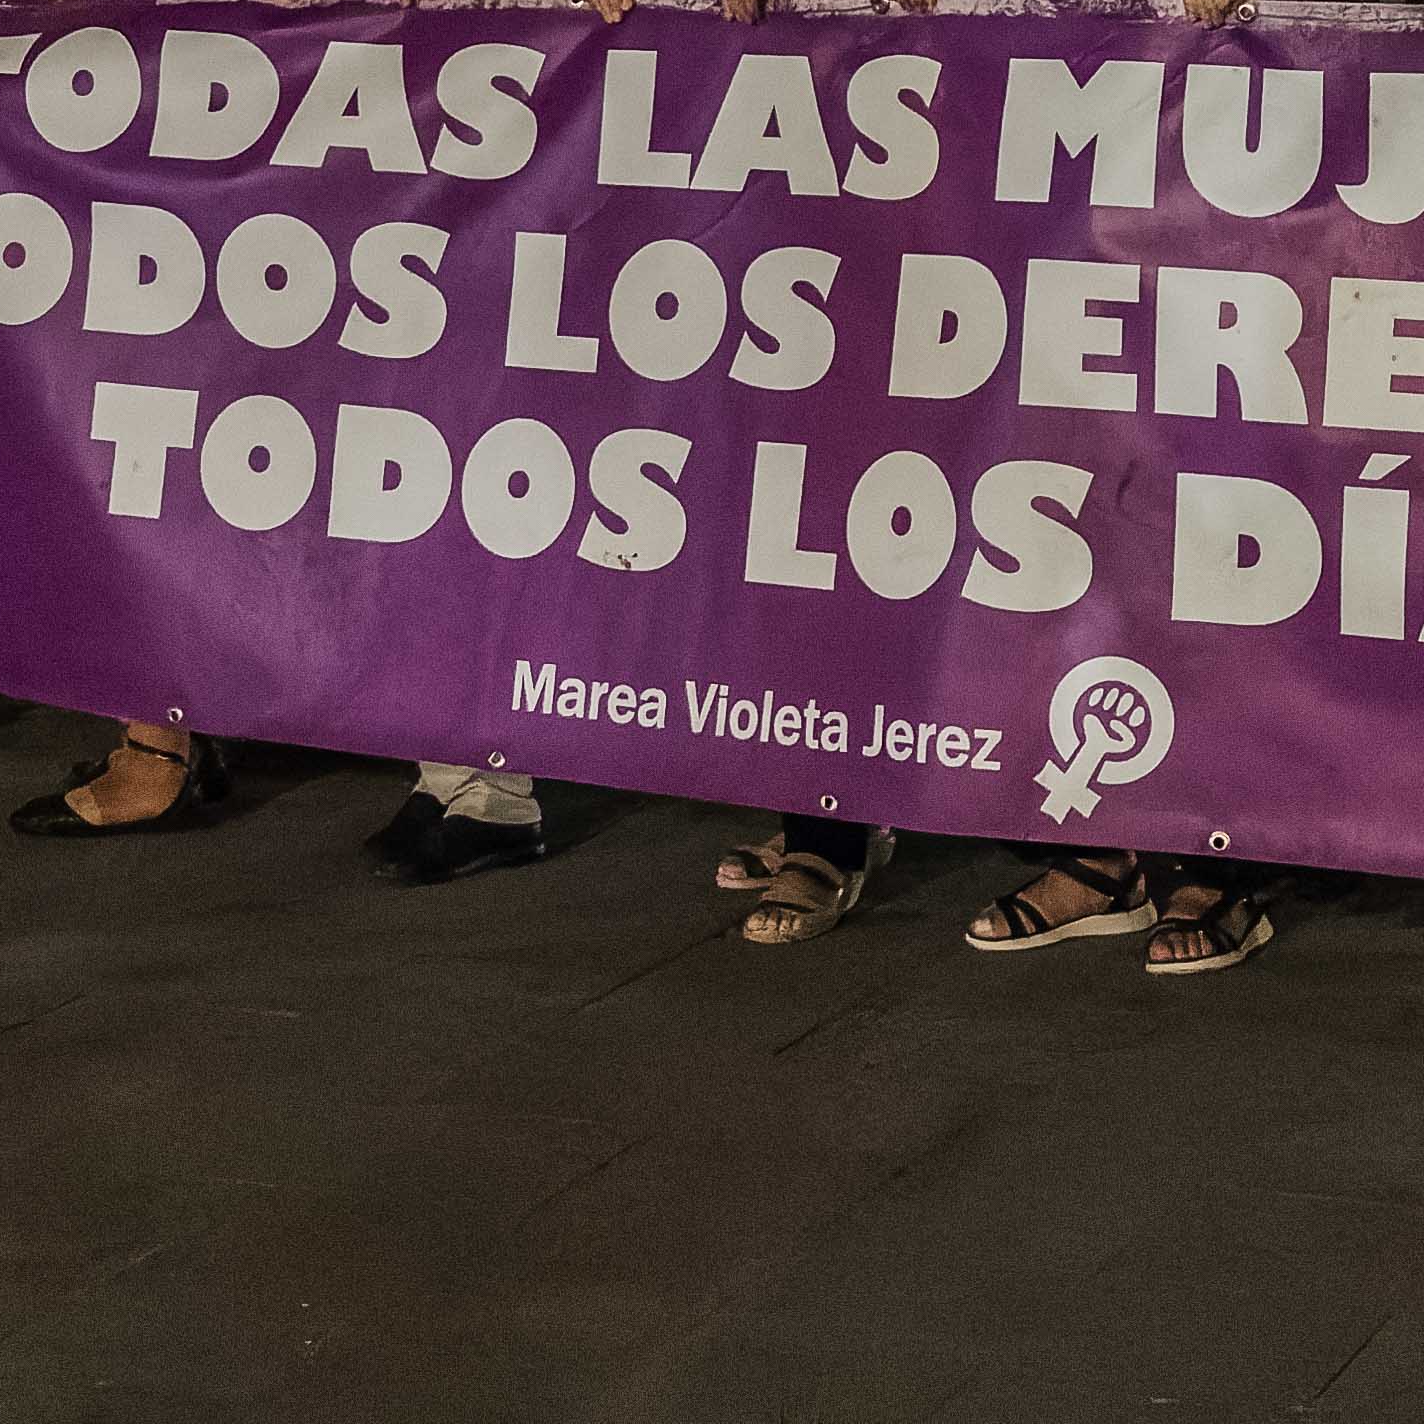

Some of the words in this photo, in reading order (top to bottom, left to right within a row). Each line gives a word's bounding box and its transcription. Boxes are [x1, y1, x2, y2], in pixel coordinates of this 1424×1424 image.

[597, 49, 942, 200] LAS
[504, 231, 841, 391] LOS
[89, 381, 692, 572] TODOS
[744, 441, 1094, 613] LOS
[511, 659, 667, 729] Marea
[684, 680, 849, 754] Violeta
[862, 704, 1003, 772] Jerez
